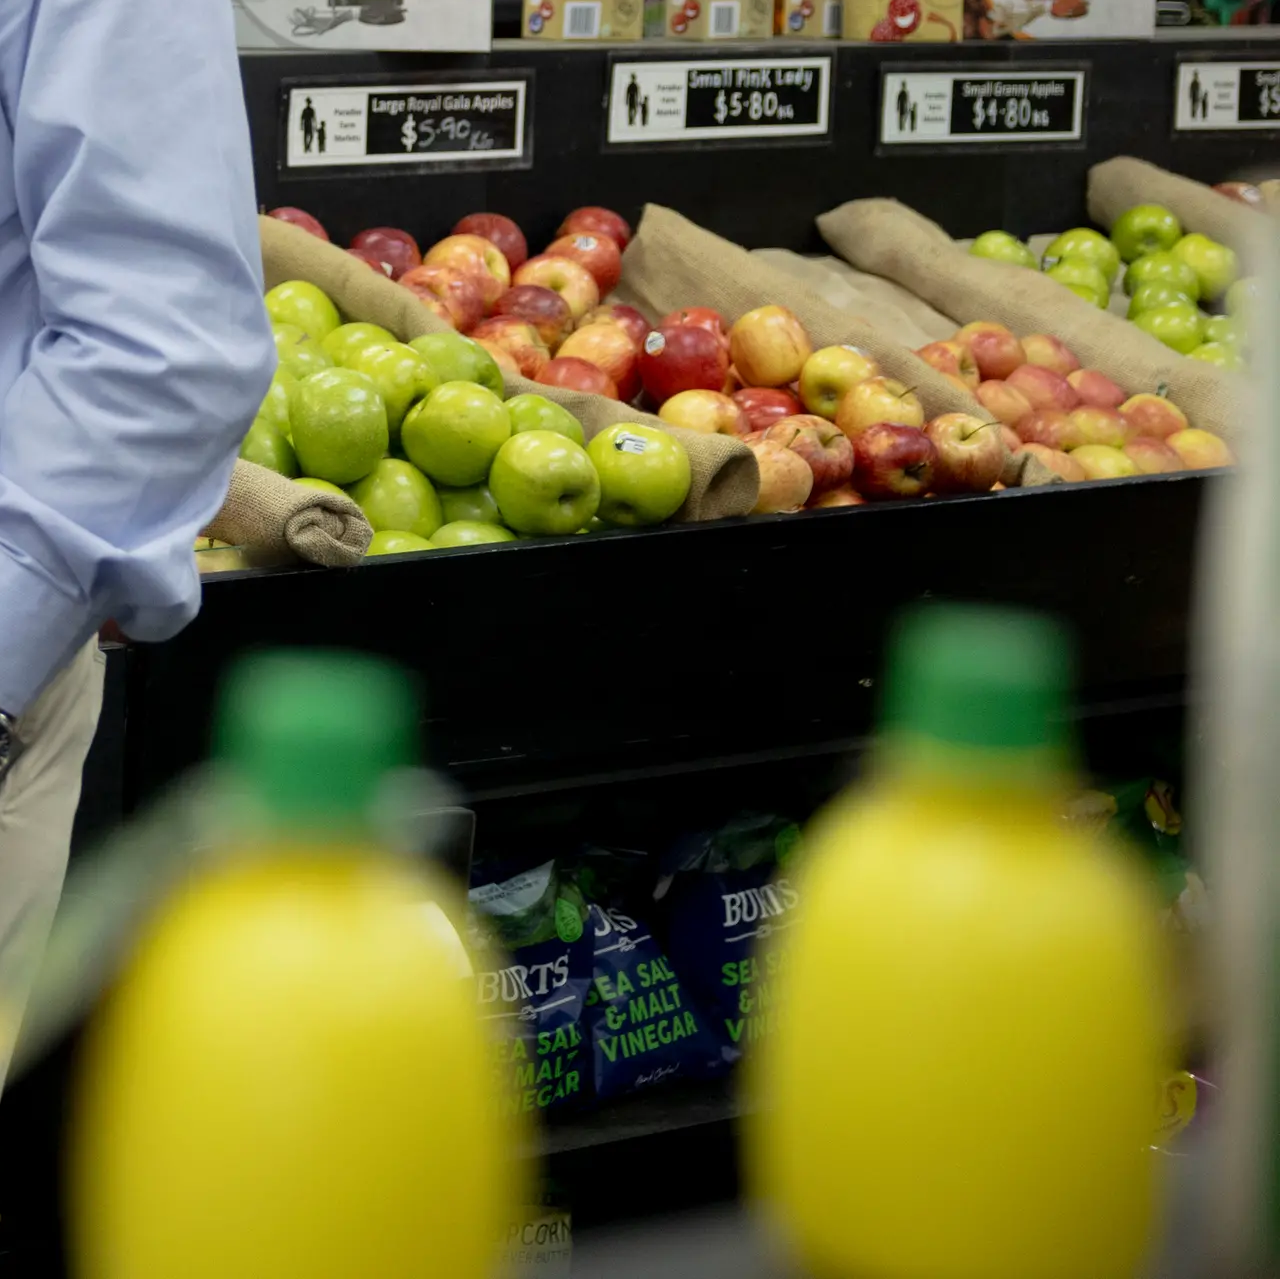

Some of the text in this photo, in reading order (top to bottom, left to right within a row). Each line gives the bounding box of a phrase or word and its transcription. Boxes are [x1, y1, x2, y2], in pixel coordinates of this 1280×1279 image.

[689, 67, 813, 92] Small Pink Lady
[962, 80, 1065, 99] Small Granny Apples
[372, 95, 514, 115] Large Royal Gala Apples
[714, 90, 778, 124] $5.80
[972, 97, 1031, 130] $4.80
[401, 114, 471, 152] $5.90
[477, 954, 569, 1004] BURTS
[605, 983, 681, 1030] & MALT
[536, 1022, 583, 1056] SAL
[598, 1010, 698, 1062] VINEGAR
[505, 1219, 573, 1246] PCORN
